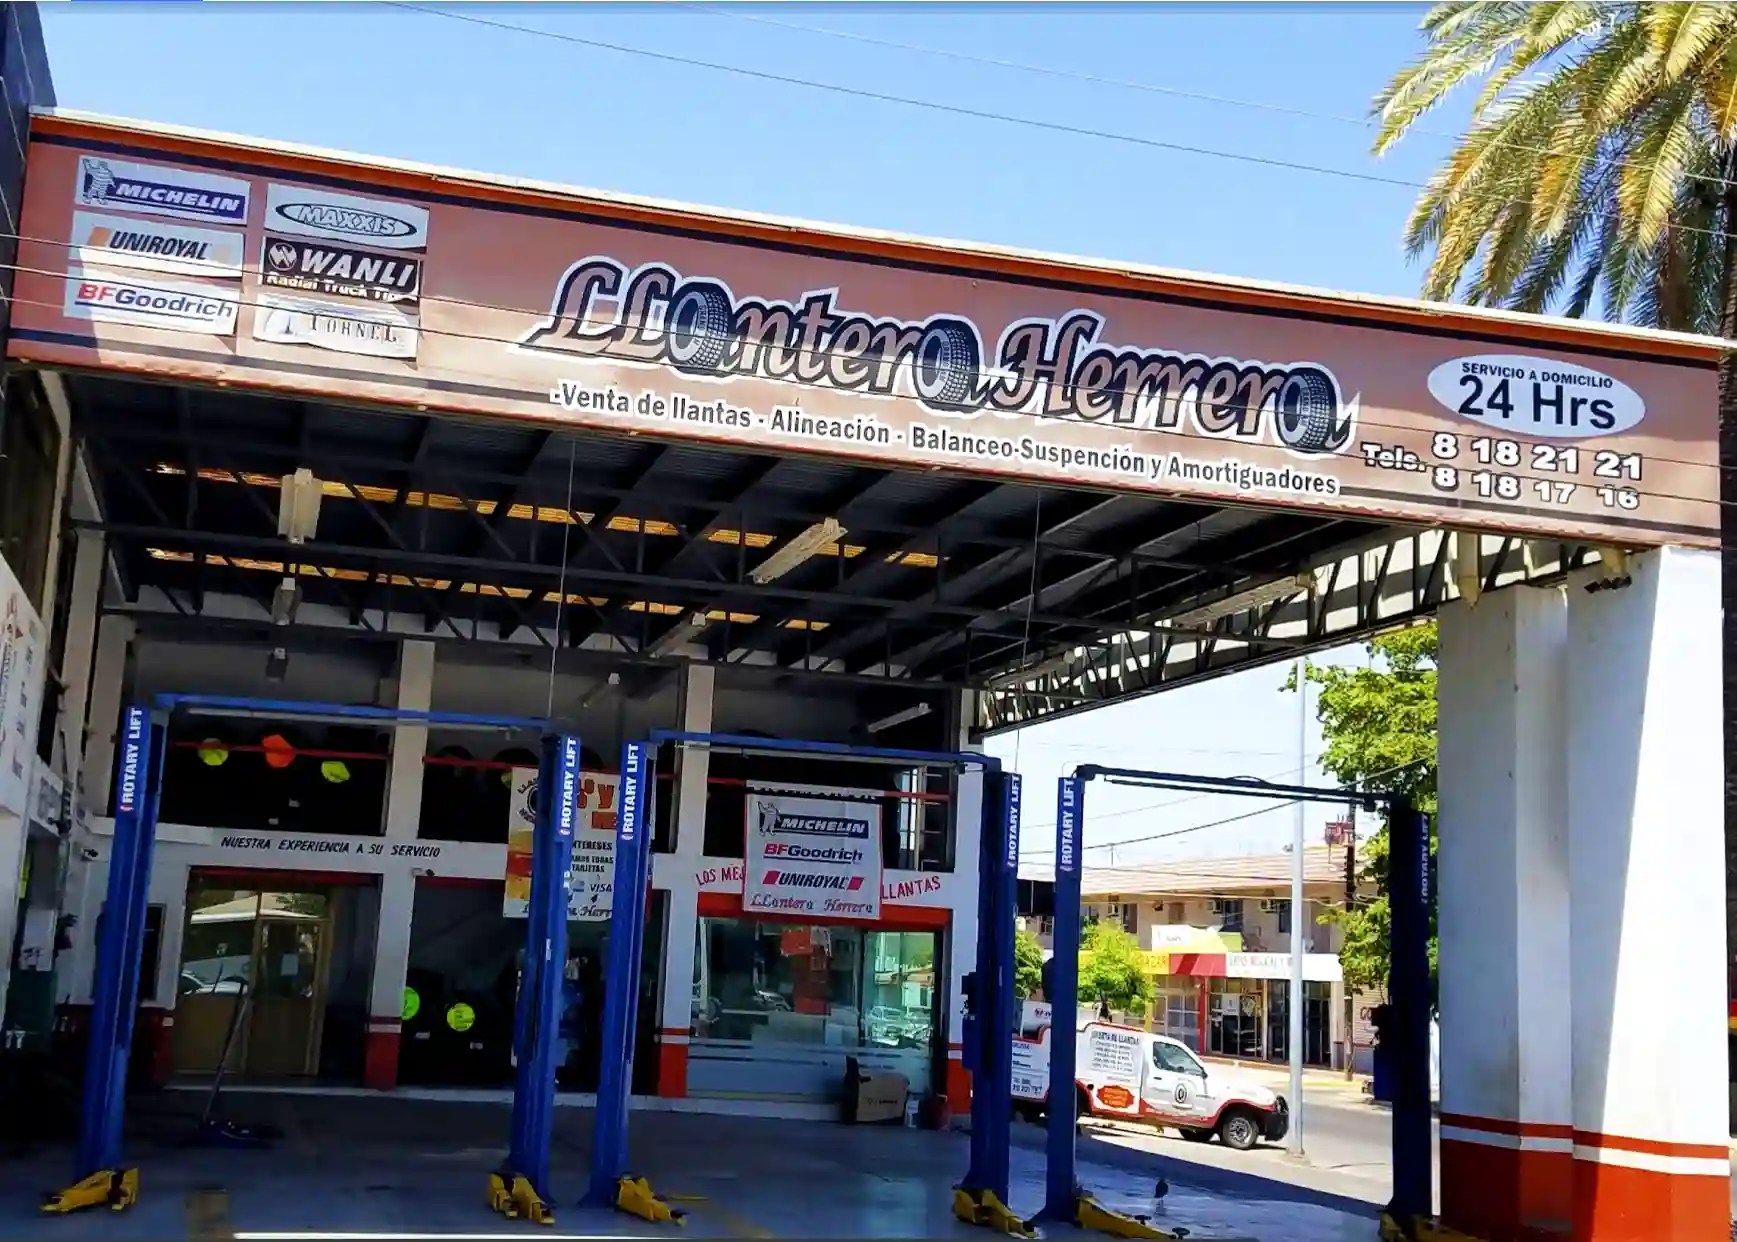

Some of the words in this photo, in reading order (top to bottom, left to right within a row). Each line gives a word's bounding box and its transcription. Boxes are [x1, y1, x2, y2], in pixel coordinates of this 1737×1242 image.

[115, 181, 241, 213] MICHELIN
[297, 204, 399, 235] MAXXIS
[109, 230, 210, 261] UNIROYAL
[300, 248, 415, 287] WANLI
[267, 271, 318, 291] Radial
[323, 279, 368, 298] Truck
[78, 281, 233, 320] BFGoodrich
[1461, 361, 1525, 380] SERVICIO
[1528, 370, 1538, 381] A
[1541, 370, 1614, 389] DOMICILIO
[1458, 374, 1514, 419] 24
[1532, 382, 1616, 430] Hrs
[637, 397, 666, 417] de
[673, 402, 751, 428] llantas
[770, 408, 890, 445] Alineación
[1151, 455, 1162, 479] y
[1168, 456, 1337, 494] Amortiguadores
[1361, 442, 1427, 473] Tels.
[1431, 432, 1459, 459] 8
[1470, 437, 1521, 467] 18
[1530, 443, 1579, 474] 21
[1593, 450, 1643, 481] 21
[1431, 465, 1459, 491] 8
[1471, 471, 1521, 500] 18
[1533, 479, 1577, 505] 17
[1597, 484, 1641, 511] 16
[128, 707, 143, 739] LIFT
[565, 737, 577, 768] LIFT
[626, 743, 639, 773] LIFT
[122, 743, 139, 804] ROTARY
[1011, 774, 1020, 803] LIFT
[561, 770, 575, 828] ROTARY
[622, 776, 637, 833] ROTARY
[1063, 778, 1075, 807] LIFT
[780, 816, 866, 834] MICHELIN
[1008, 805, 1018, 861] ROTARY
[1061, 809, 1074, 865] ROTARY
[221, 836, 272, 850] NUESTRA
[278, 839, 350, 854] EXPERIENCIA
[355, 843, 364, 854] A
[369, 843, 384, 855] SU
[390, 844, 441, 858] SERVICIO
[763, 842, 863, 861] BFGoodrich
[590, 883, 612, 893] VISA
[695, 868, 717, 886] LOS
[778, 871, 848, 889] UNIROYAL
[880, 875, 941, 900] LLANTAS
